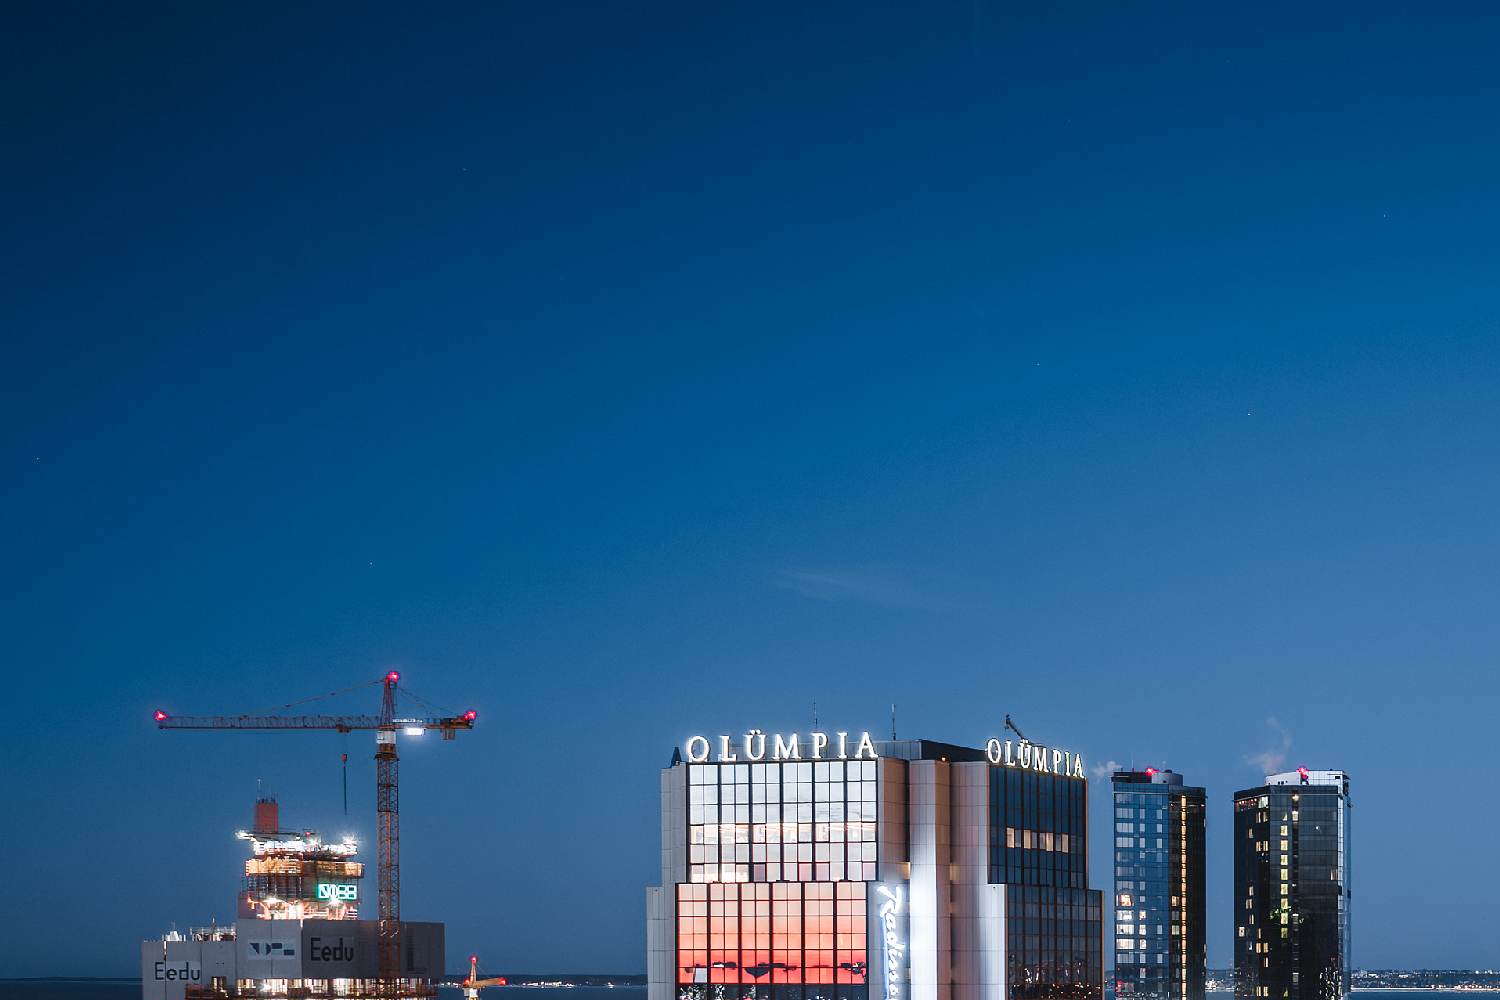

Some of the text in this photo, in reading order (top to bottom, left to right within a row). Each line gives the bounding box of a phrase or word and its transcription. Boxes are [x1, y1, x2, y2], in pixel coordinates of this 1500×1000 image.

[686, 729, 878, 762] OLÜMPIA
[986, 738, 1085, 779] OLÜMPIA
[154, 961, 200, 981] Eedu
